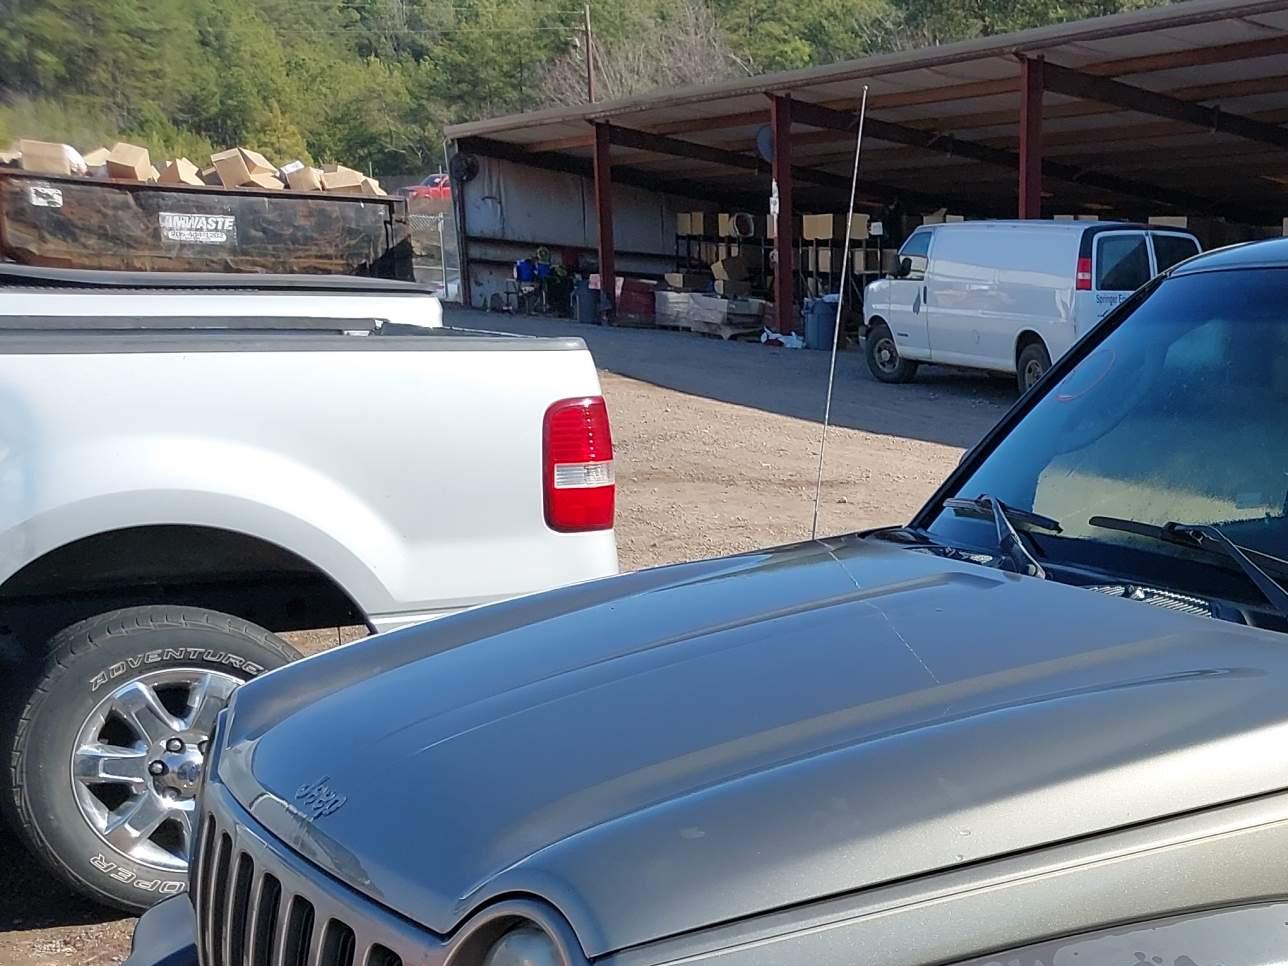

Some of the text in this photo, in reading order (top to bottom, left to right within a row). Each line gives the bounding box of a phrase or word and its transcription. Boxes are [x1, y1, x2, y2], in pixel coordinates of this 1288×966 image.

[90, 647, 269, 692] ADVENTURE
[295, 776, 347, 822] Jeep
[90, 855, 185, 894] OPER
